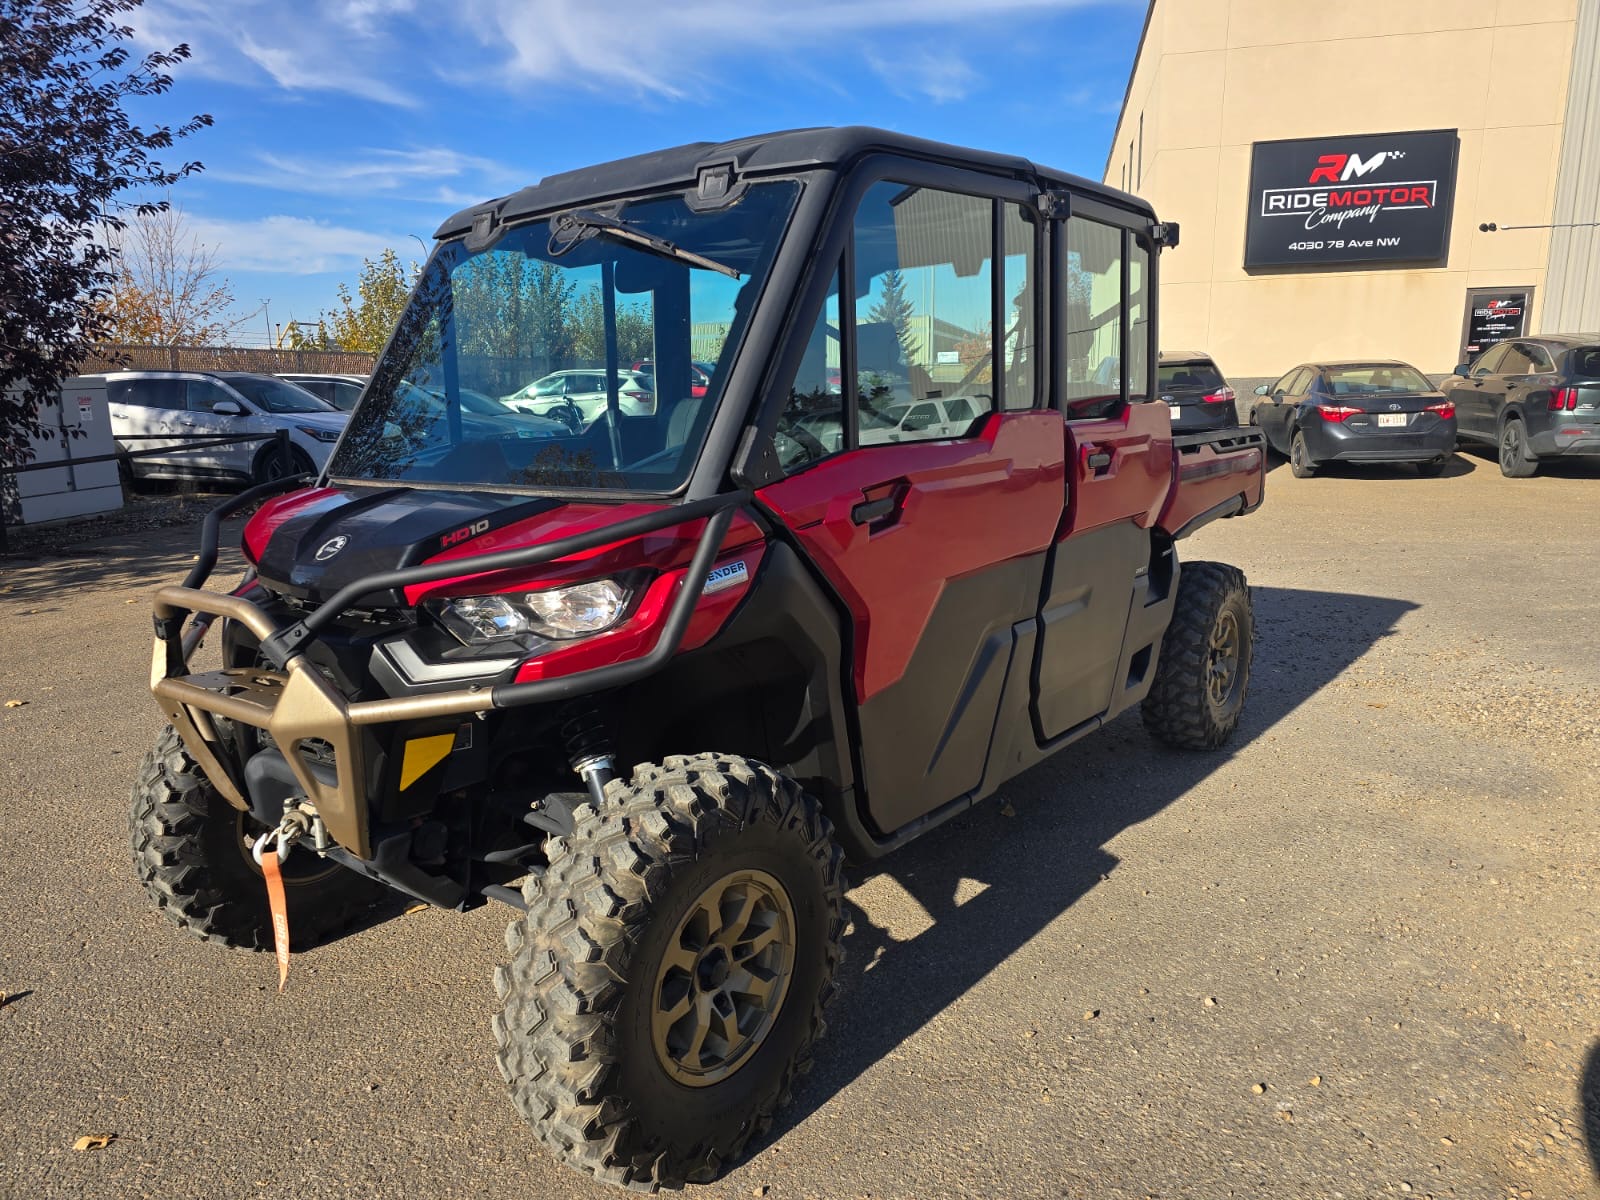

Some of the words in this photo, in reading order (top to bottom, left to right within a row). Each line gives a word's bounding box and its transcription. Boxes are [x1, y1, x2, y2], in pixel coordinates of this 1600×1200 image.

[1309, 152, 1387, 183] RM
[1305, 204, 1383, 230] Company
[1288, 241, 1324, 250] 4030
[1327, 240, 1345, 249] 78
[1348, 239, 1374, 248] Ave
[1376, 237, 1401, 247] NW
[442, 519, 489, 547] HD10
